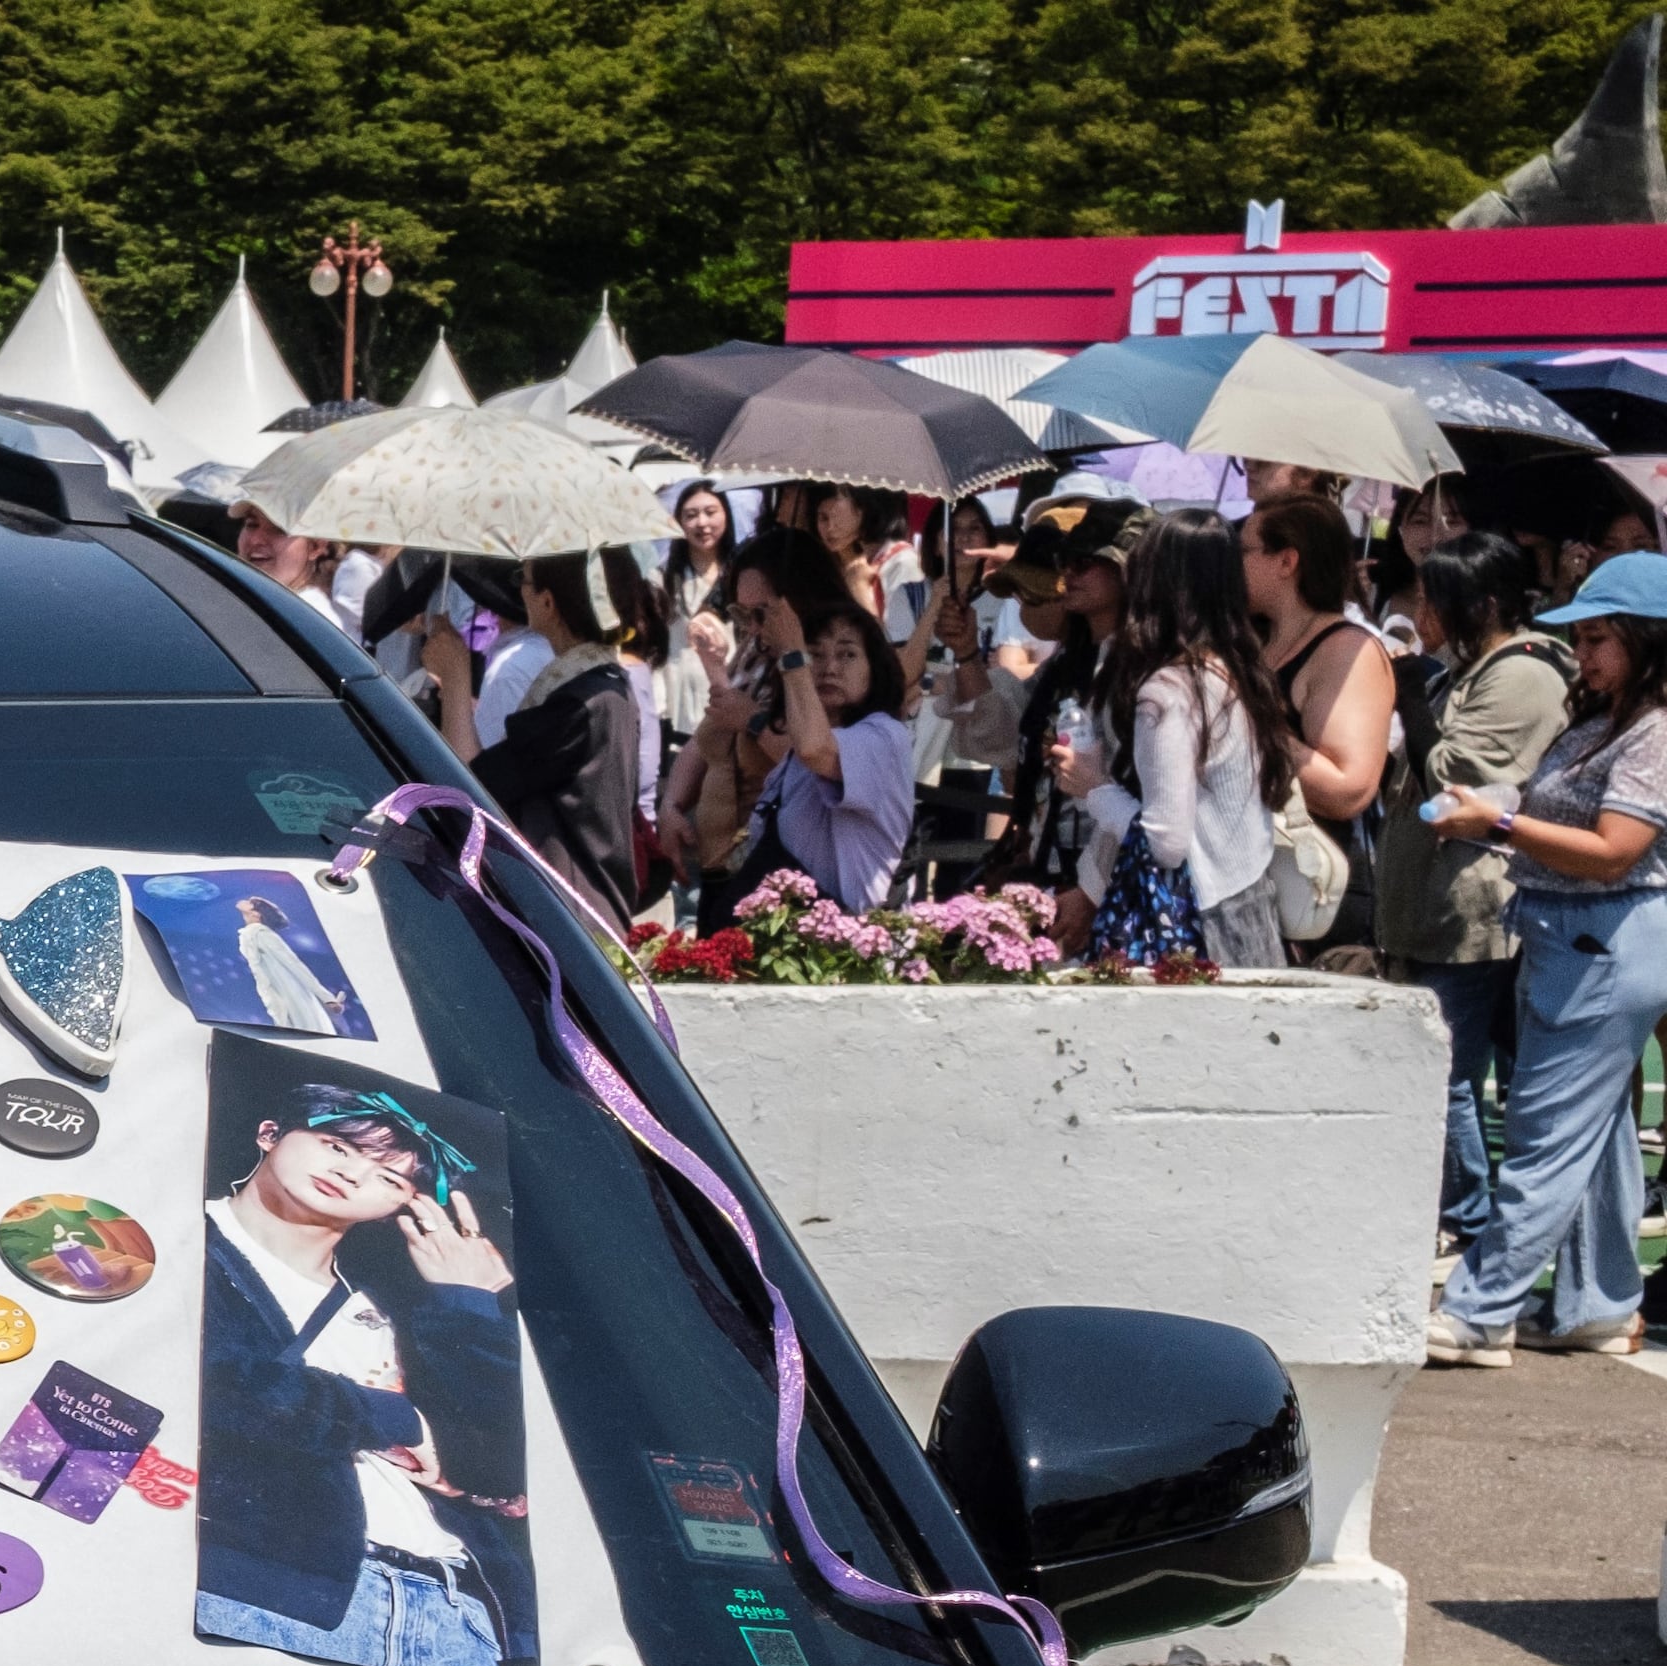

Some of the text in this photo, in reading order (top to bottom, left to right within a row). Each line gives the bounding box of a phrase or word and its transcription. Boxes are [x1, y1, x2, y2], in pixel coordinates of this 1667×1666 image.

[1129, 274, 1389, 335] FESTA
[7, 1092, 86, 1115] MAP OF THE SOUL
[5, 1101, 86, 1135] TOUR
[53, 1385, 139, 1437] Yet to Come
[91, 1392, 112, 1409] BTS
[59, 1404, 118, 1439] in Cinemas
[733, 1588, 765, 1603] 주차
[726, 1604, 790, 1621] 안심번호
